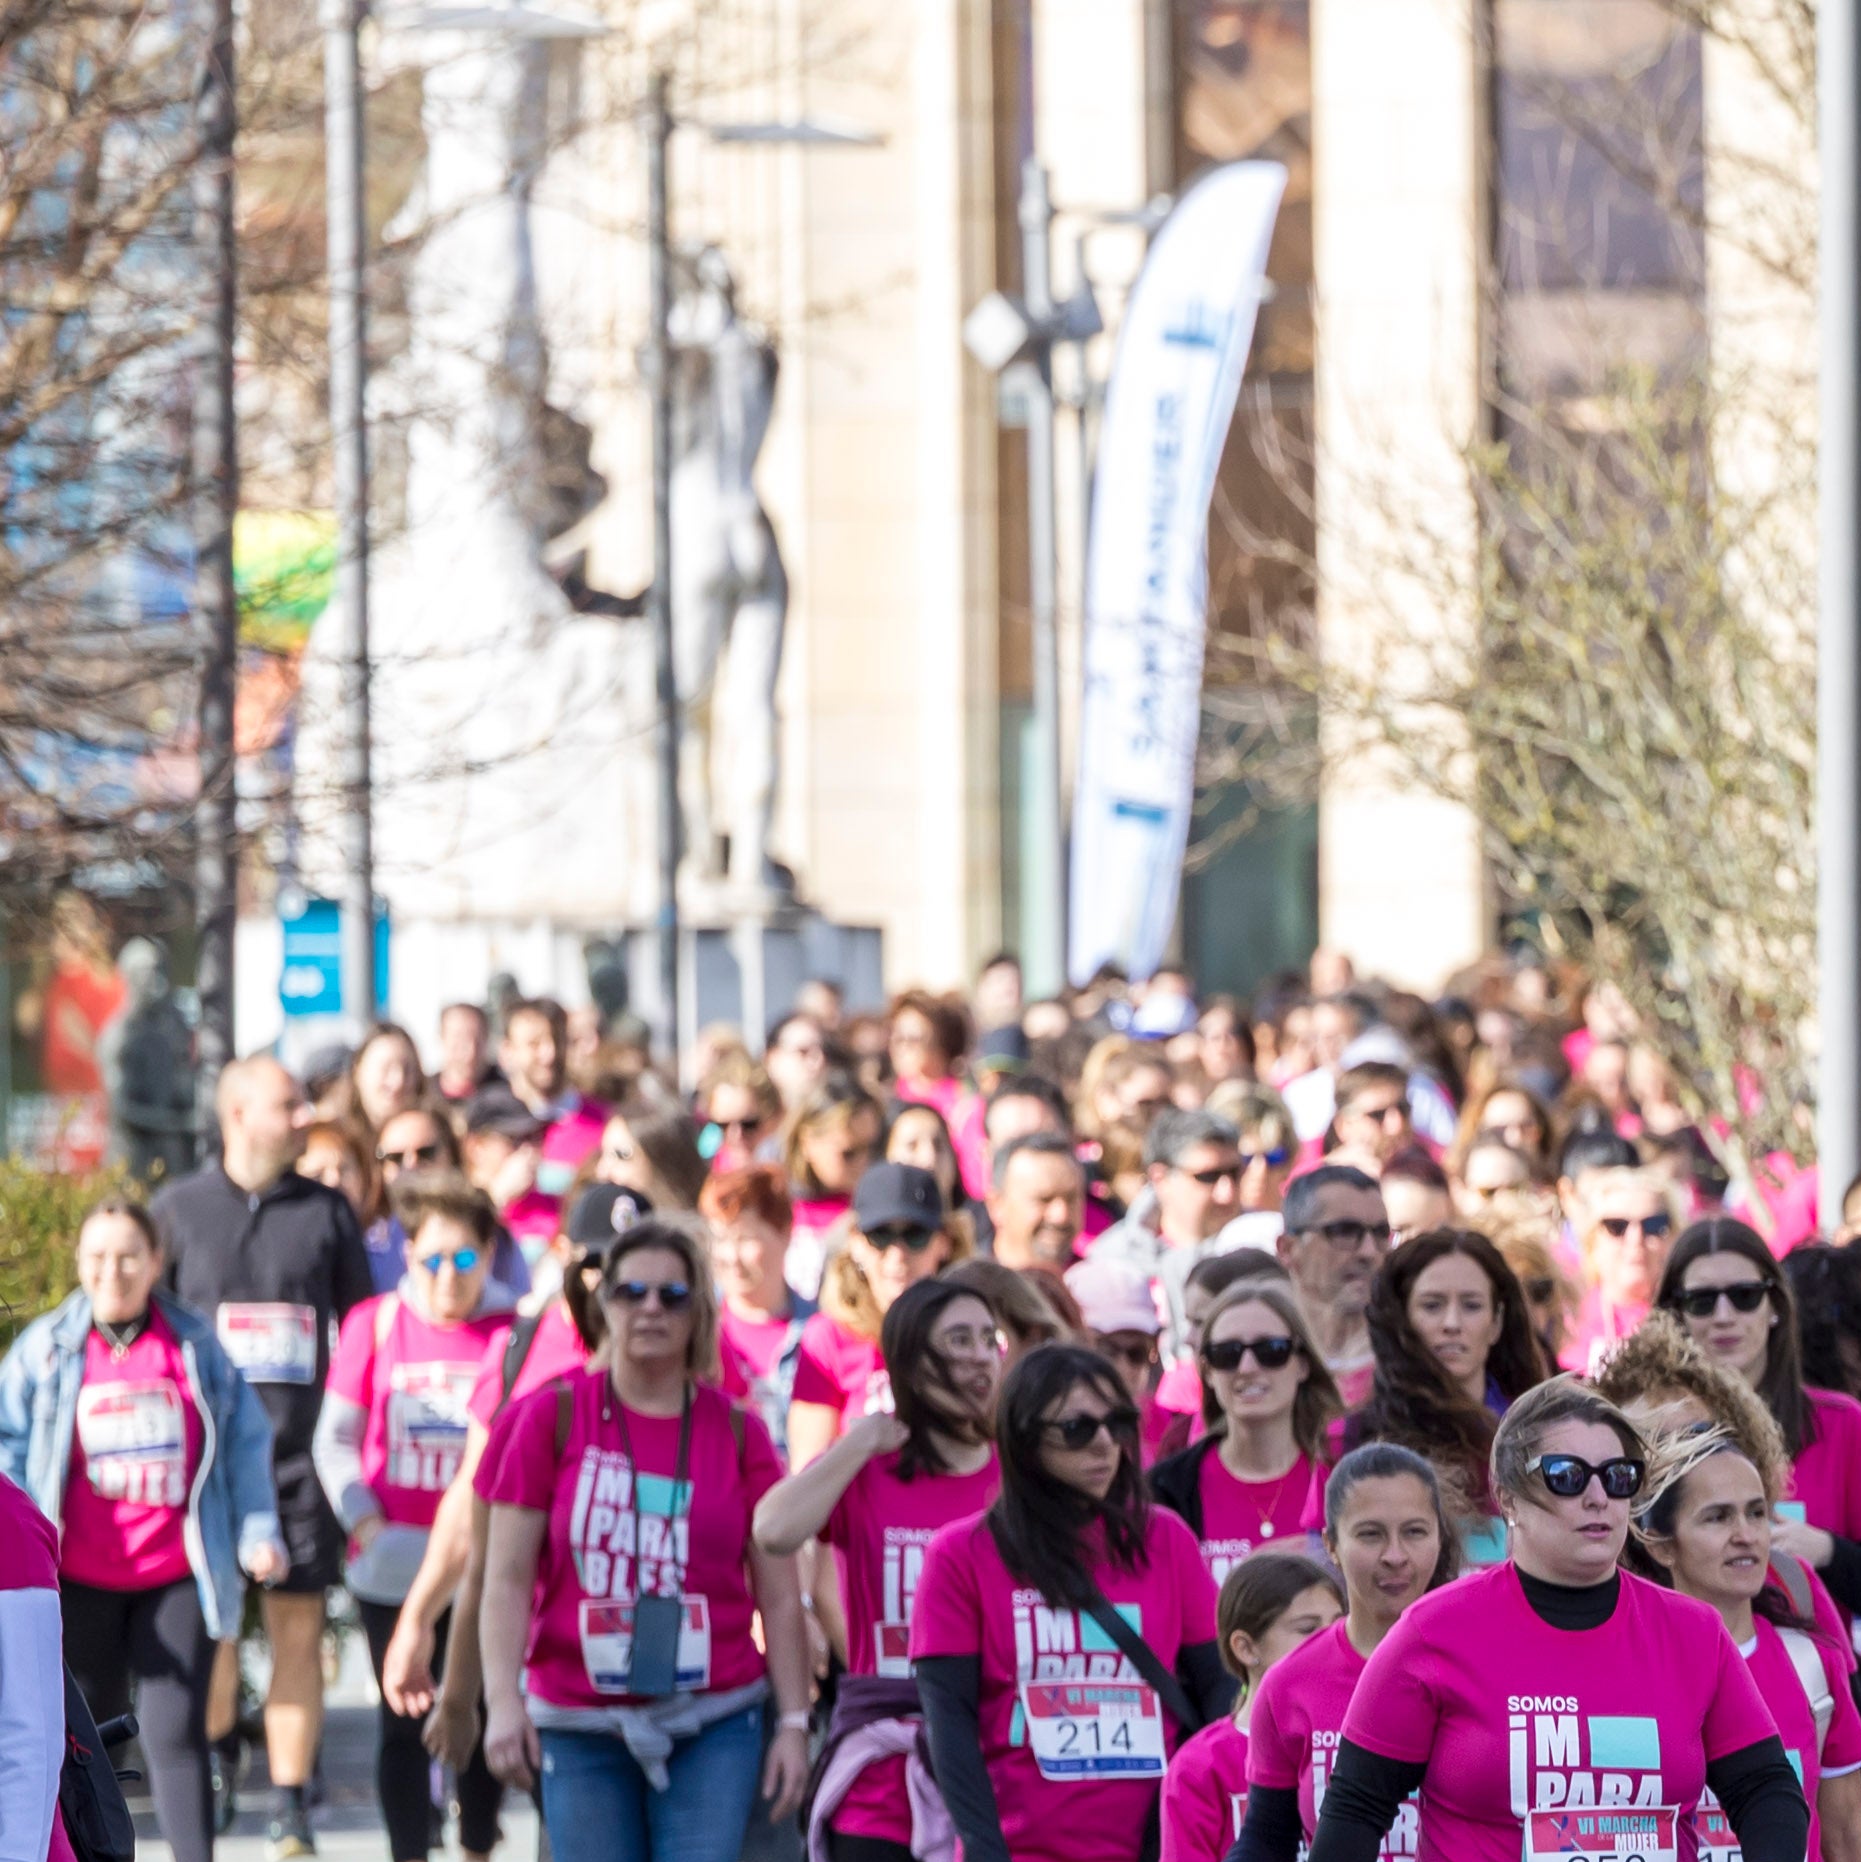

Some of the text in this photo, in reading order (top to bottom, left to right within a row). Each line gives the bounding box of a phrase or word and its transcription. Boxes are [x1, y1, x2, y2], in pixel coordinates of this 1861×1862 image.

[1508, 1696, 1578, 1712] SOMOS
[1057, 1719, 1133, 1754] 214
[1577, 1816, 1658, 1835] VI MARCHA
